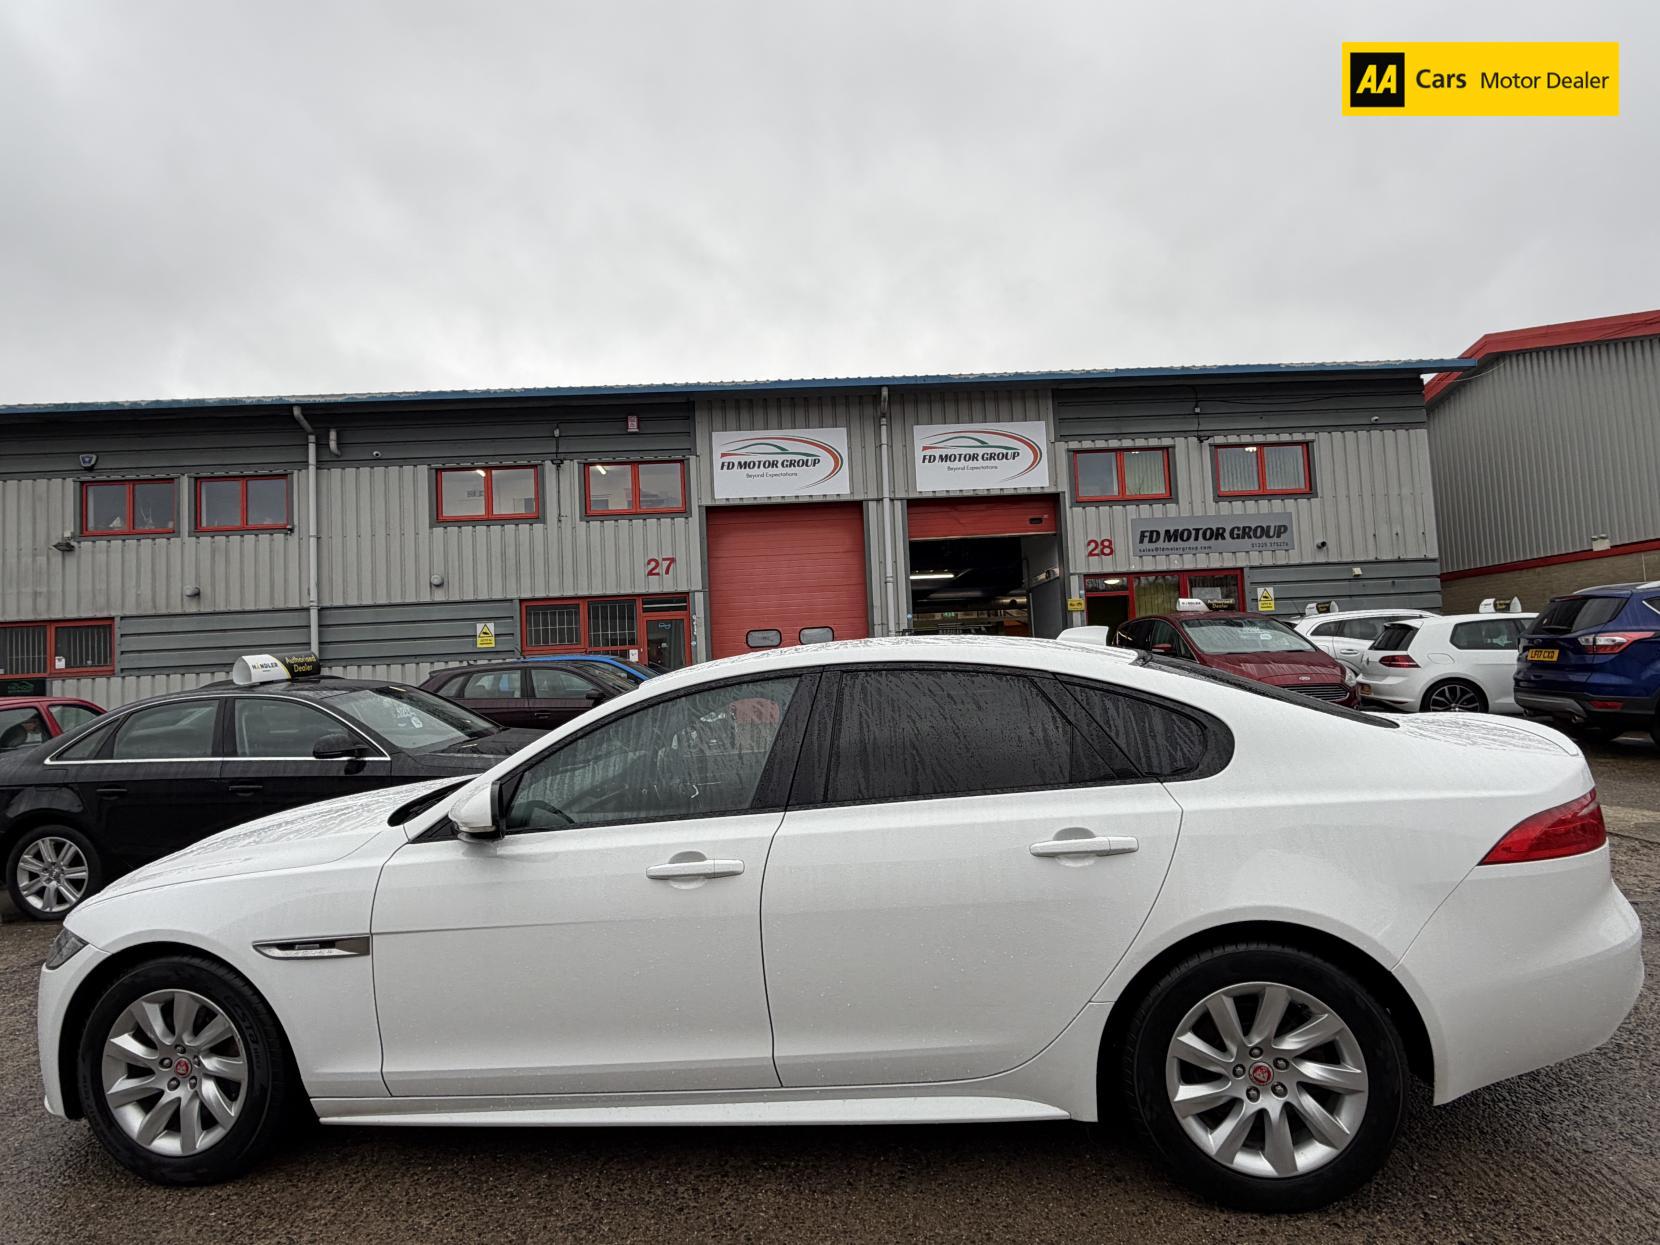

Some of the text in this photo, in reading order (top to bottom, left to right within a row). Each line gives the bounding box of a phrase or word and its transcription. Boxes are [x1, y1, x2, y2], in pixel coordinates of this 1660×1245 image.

[720, 457, 821, 471] FD MOTOR GROUP
[921, 451, 1020, 464] FD MOTOR GROUP
[765, 470, 798, 479] Expectations
[947, 465, 966, 473] Beyond
[1138, 524, 1289, 545] FD MOTOR GROUP
[1087, 539, 1113, 557] 28
[646, 557, 676, 576] 27
[293, 663, 313, 672] Dealer
